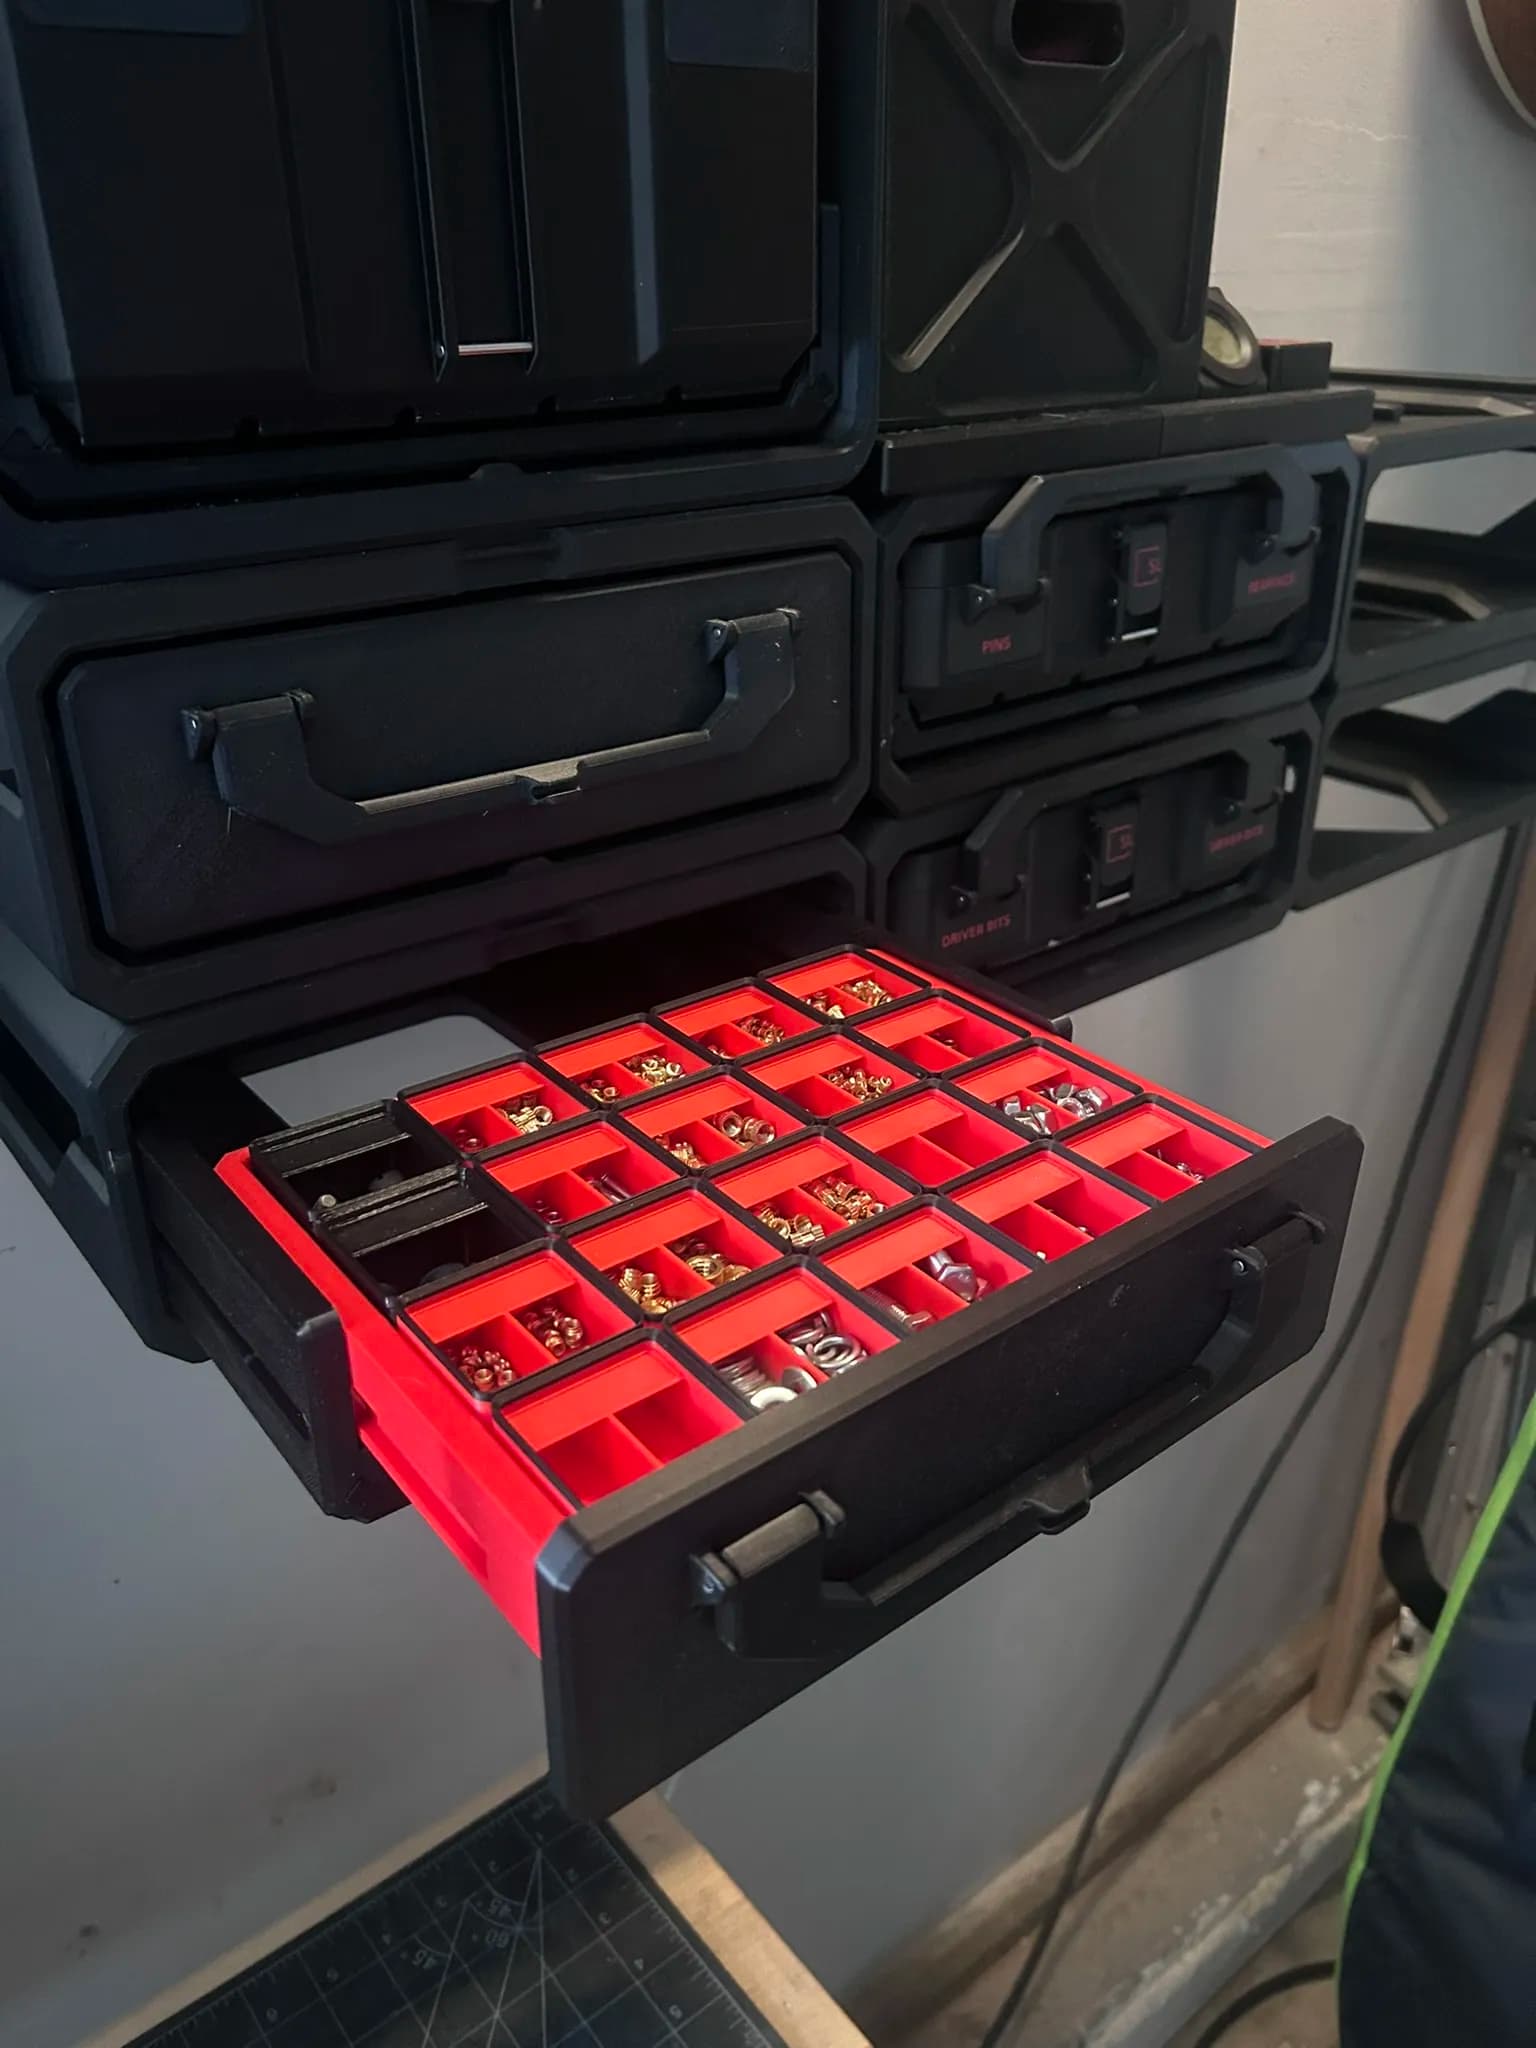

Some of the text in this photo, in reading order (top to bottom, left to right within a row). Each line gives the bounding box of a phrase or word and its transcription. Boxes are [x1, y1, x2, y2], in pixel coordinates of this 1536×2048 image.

[982, 634, 1012, 655] PINS
[940, 912, 1012, 948] DRIVER BITS
